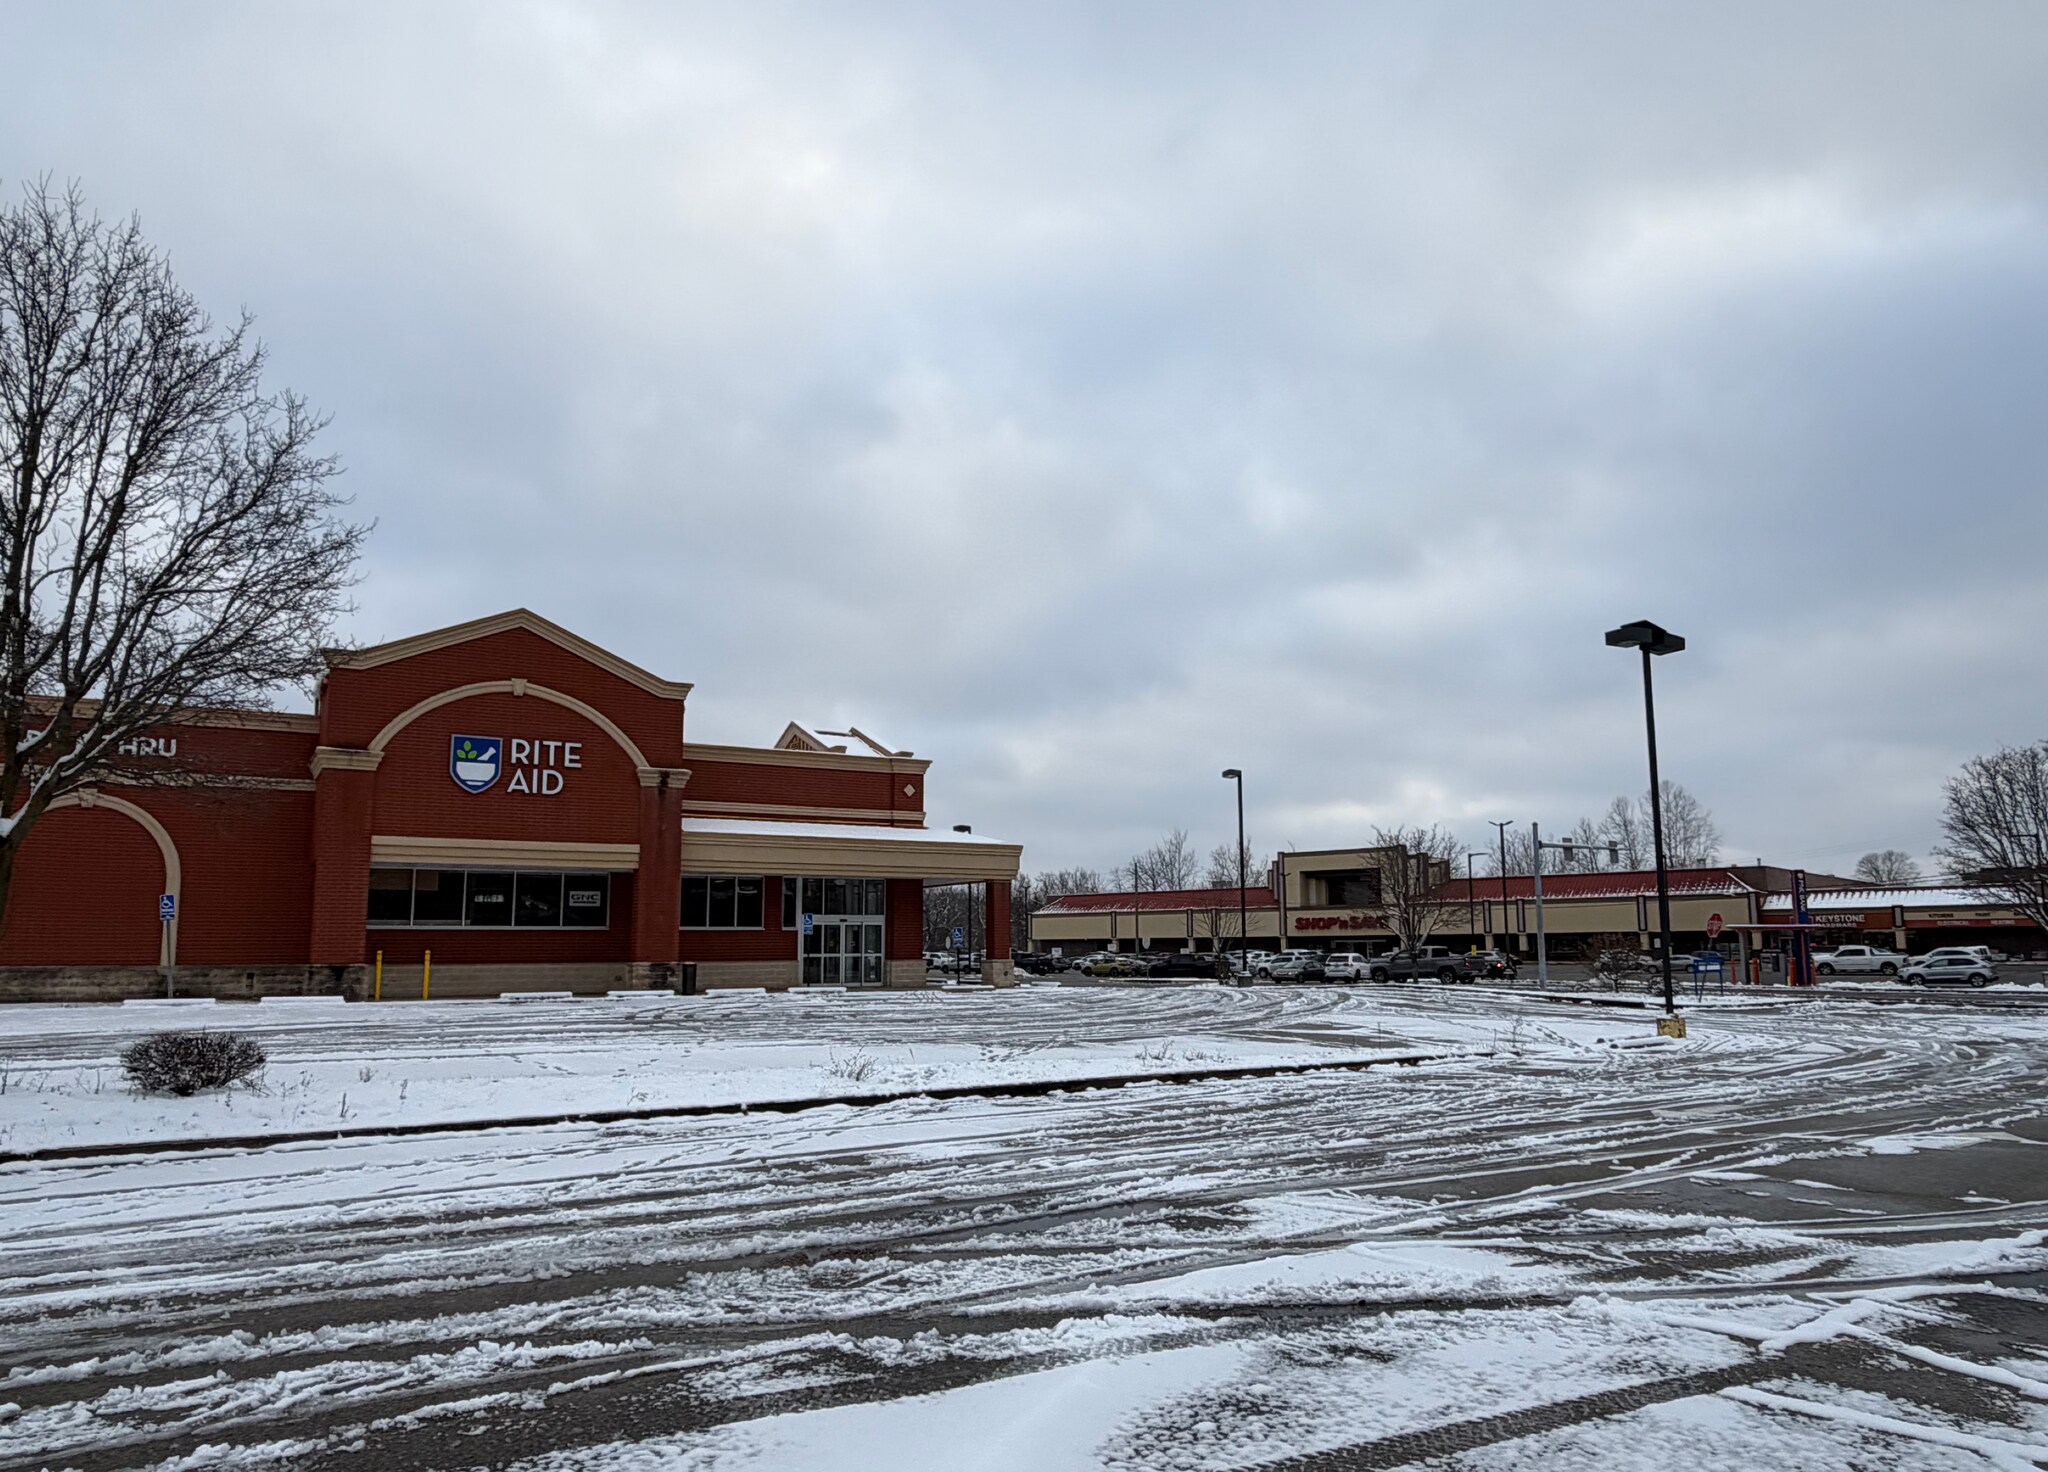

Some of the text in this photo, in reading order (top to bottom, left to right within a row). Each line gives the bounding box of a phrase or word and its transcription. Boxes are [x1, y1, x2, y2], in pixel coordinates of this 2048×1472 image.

[110, 736, 177, 757] HRU
[510, 738, 582, 768] RITE
[507, 768, 564, 795] AID
[570, 893, 599, 901] GNC
[1799, 894, 1807, 913] BANK
[1707, 920, 1722, 930] STOP
[1815, 914, 1866, 923] KEYSTONE
